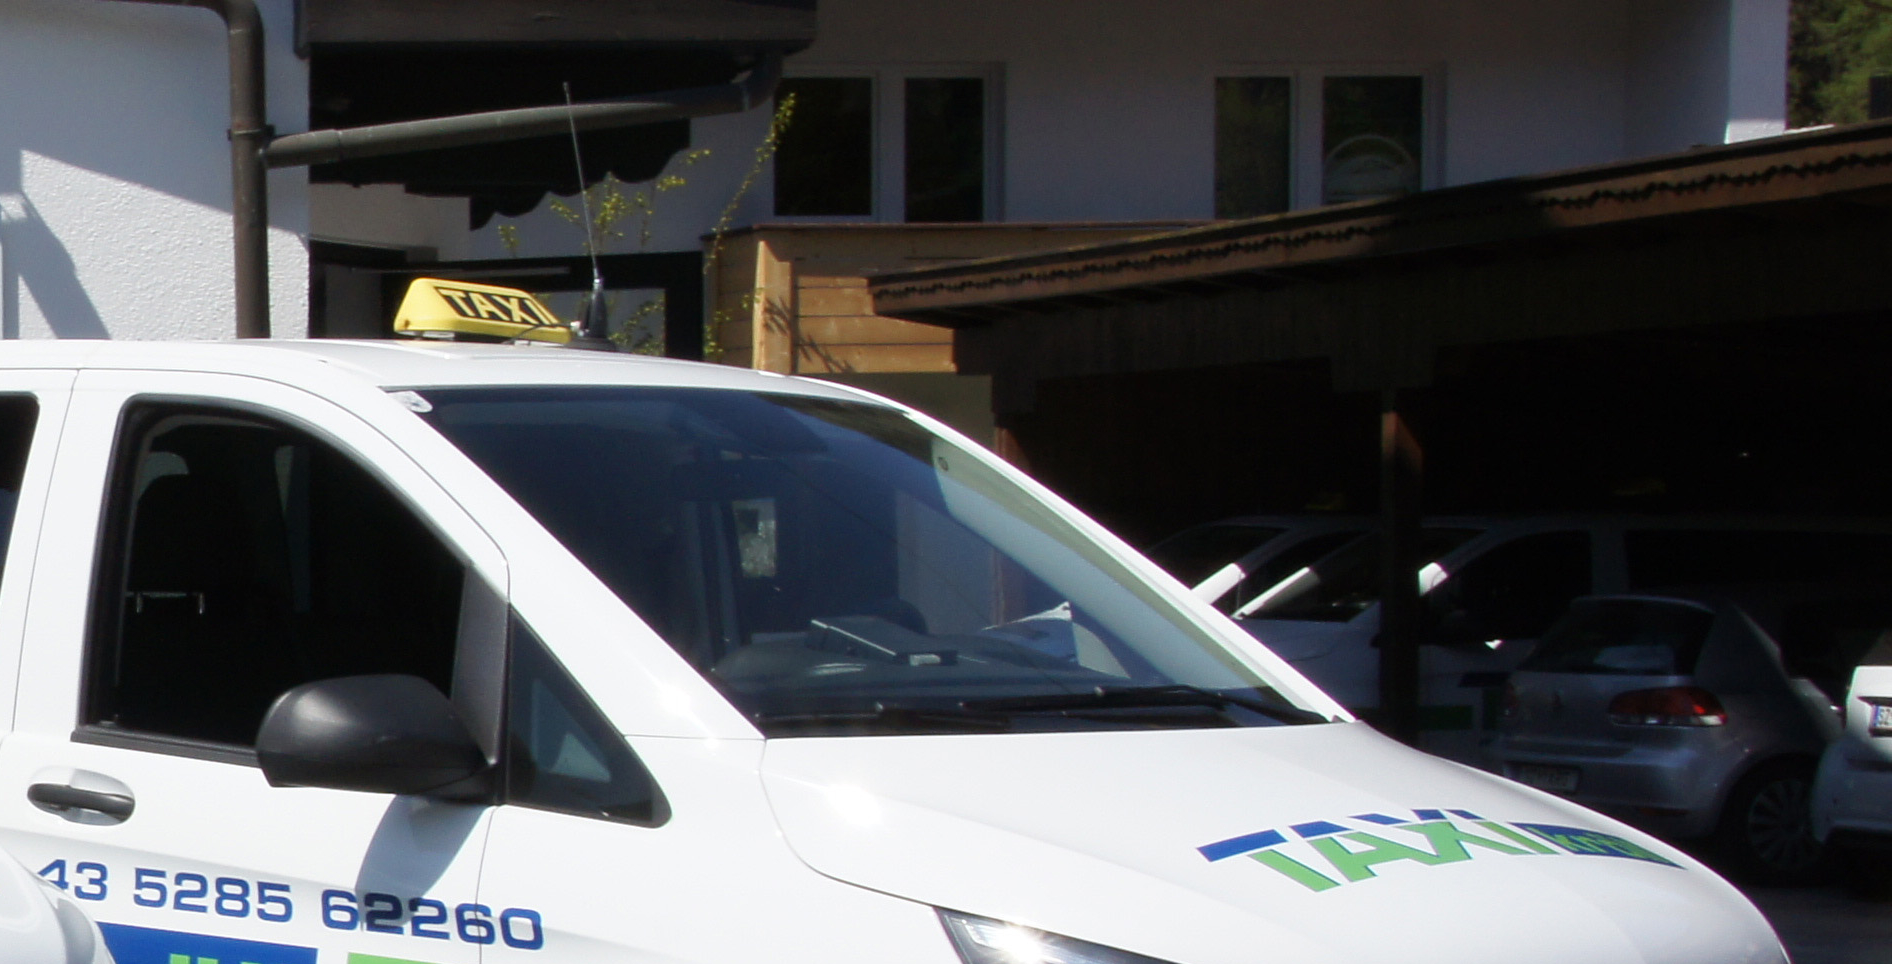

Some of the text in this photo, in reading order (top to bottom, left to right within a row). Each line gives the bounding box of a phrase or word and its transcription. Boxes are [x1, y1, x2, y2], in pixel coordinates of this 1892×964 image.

[438, 288, 560, 325] TAXI
[1195, 808, 1561, 892] TAXI
[132, 866, 295, 923] 5285
[321, 888, 544, 951] 62260
